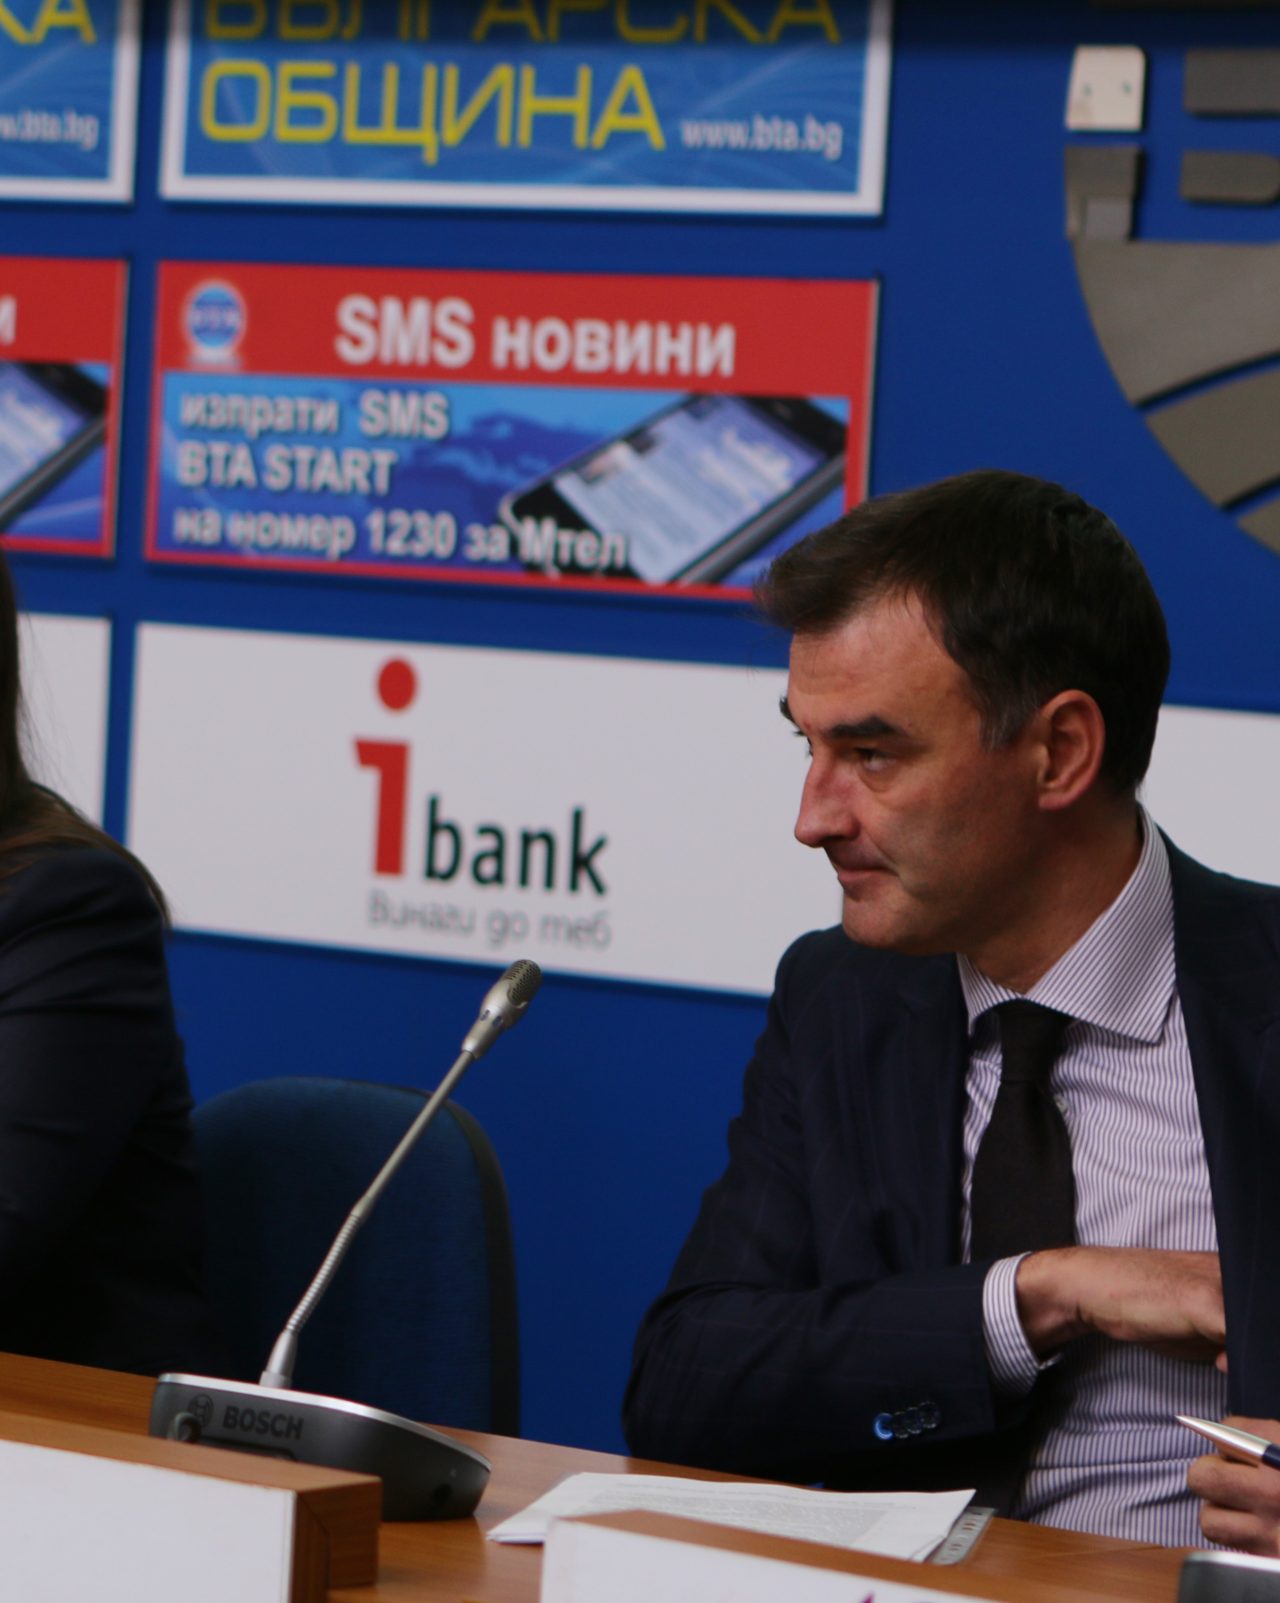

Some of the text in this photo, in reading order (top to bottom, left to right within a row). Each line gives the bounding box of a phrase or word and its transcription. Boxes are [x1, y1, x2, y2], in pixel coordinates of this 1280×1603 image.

[199, 59, 843, 166] ОБЩИНА www.bta.bg
[335, 296, 475, 369] SMS
[179, 390, 450, 440] изпрати SMS
[177, 442, 398, 495] BTA START
[174, 507, 222, 544] на
[228, 510, 357, 560] номер
[365, 509, 456, 557] 1230
[464, 522, 511, 563] за
[222, 1404, 304, 1441] BOSCH
